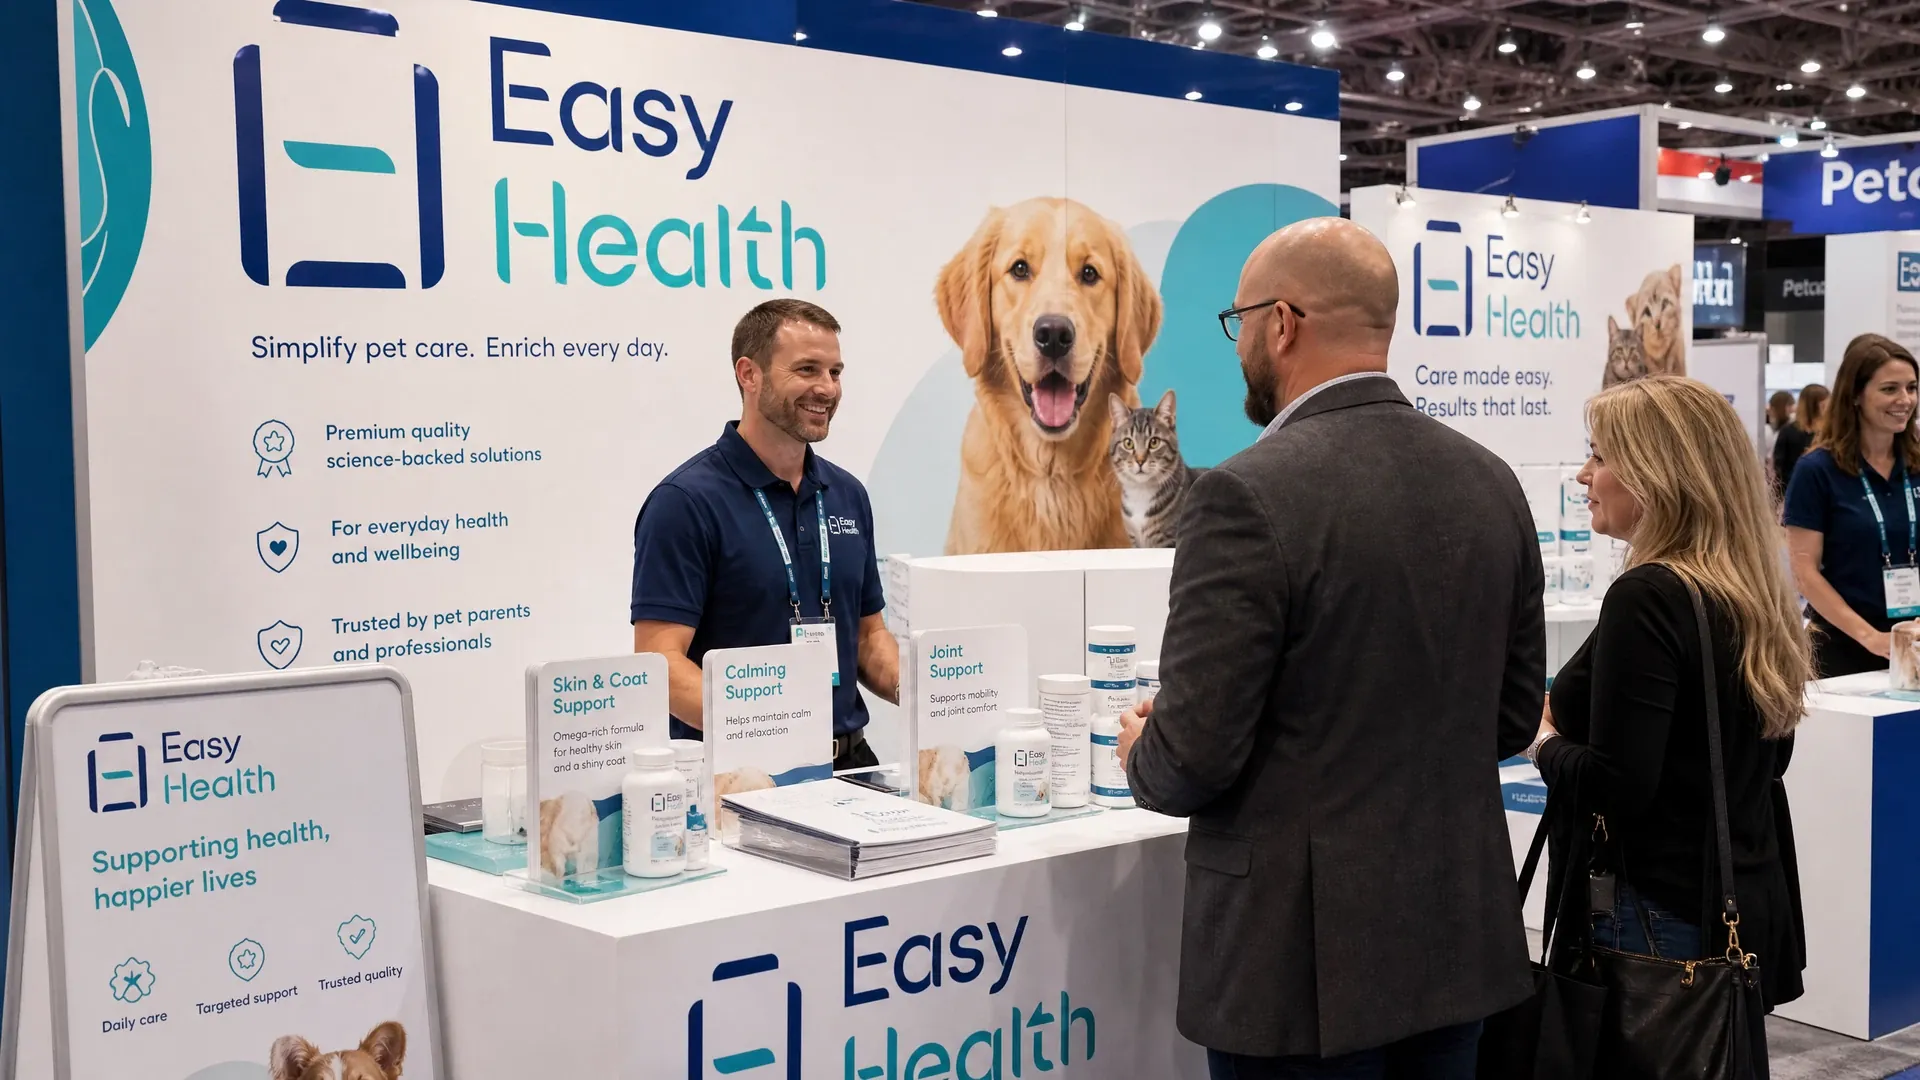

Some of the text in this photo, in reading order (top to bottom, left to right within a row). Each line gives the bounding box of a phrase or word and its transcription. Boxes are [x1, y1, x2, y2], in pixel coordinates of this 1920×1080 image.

[489, 35, 735, 181] Easy
[494, 176, 828, 292] Health
[1487, 234, 1555, 291] Easy
[1486, 294, 1581, 340] Health
[251, 335, 668, 365] Simplify pet care. Enrich every day.
[1415, 364, 1553, 390] Care made easy.
[1415, 395, 1552, 418] Results that last.
[326, 421, 471, 443] Premium quality
[326, 446, 542, 469] science-backed solutions
[331, 511, 509, 537] For everyday health
[838, 516, 856, 528] Easy
[331, 542, 460, 565] and wellbeing
[331, 603, 531, 635] Trusted by pet parents
[332, 632, 493, 664] and professionals
[929, 644, 964, 660] Joint
[553, 671, 648, 694] Skin & Coat
[725, 662, 786, 680] Calming
[929, 661, 984, 681] Support
[725, 682, 783, 702] Support
[929, 688, 999, 705] Supports mobility
[553, 694, 616, 717] Support
[725, 708, 812, 726] Helps maintain calm
[929, 702, 998, 718] and joint comfort
[553, 722, 644, 742] Omega-rich formula
[726, 725, 789, 741] and relaxation
[161, 730, 242, 764] Easy
[553, 740, 622, 758] for healthy skin
[1028, 750, 1046, 760] Easy
[553, 761, 572, 773] and
[581, 759, 604, 770] shiny
[605, 755, 626, 767] coat
[162, 763, 277, 805] Health
[92, 819, 330, 875] Supporting health,
[94, 869, 257, 912] happier lives
[844, 915, 1030, 1008] Easy
[317, 966, 403, 991] Trusted quality
[195, 985, 299, 1015] Targeted support
[102, 1012, 168, 1034] Daily care
[844, 990, 1097, 1080] Health
